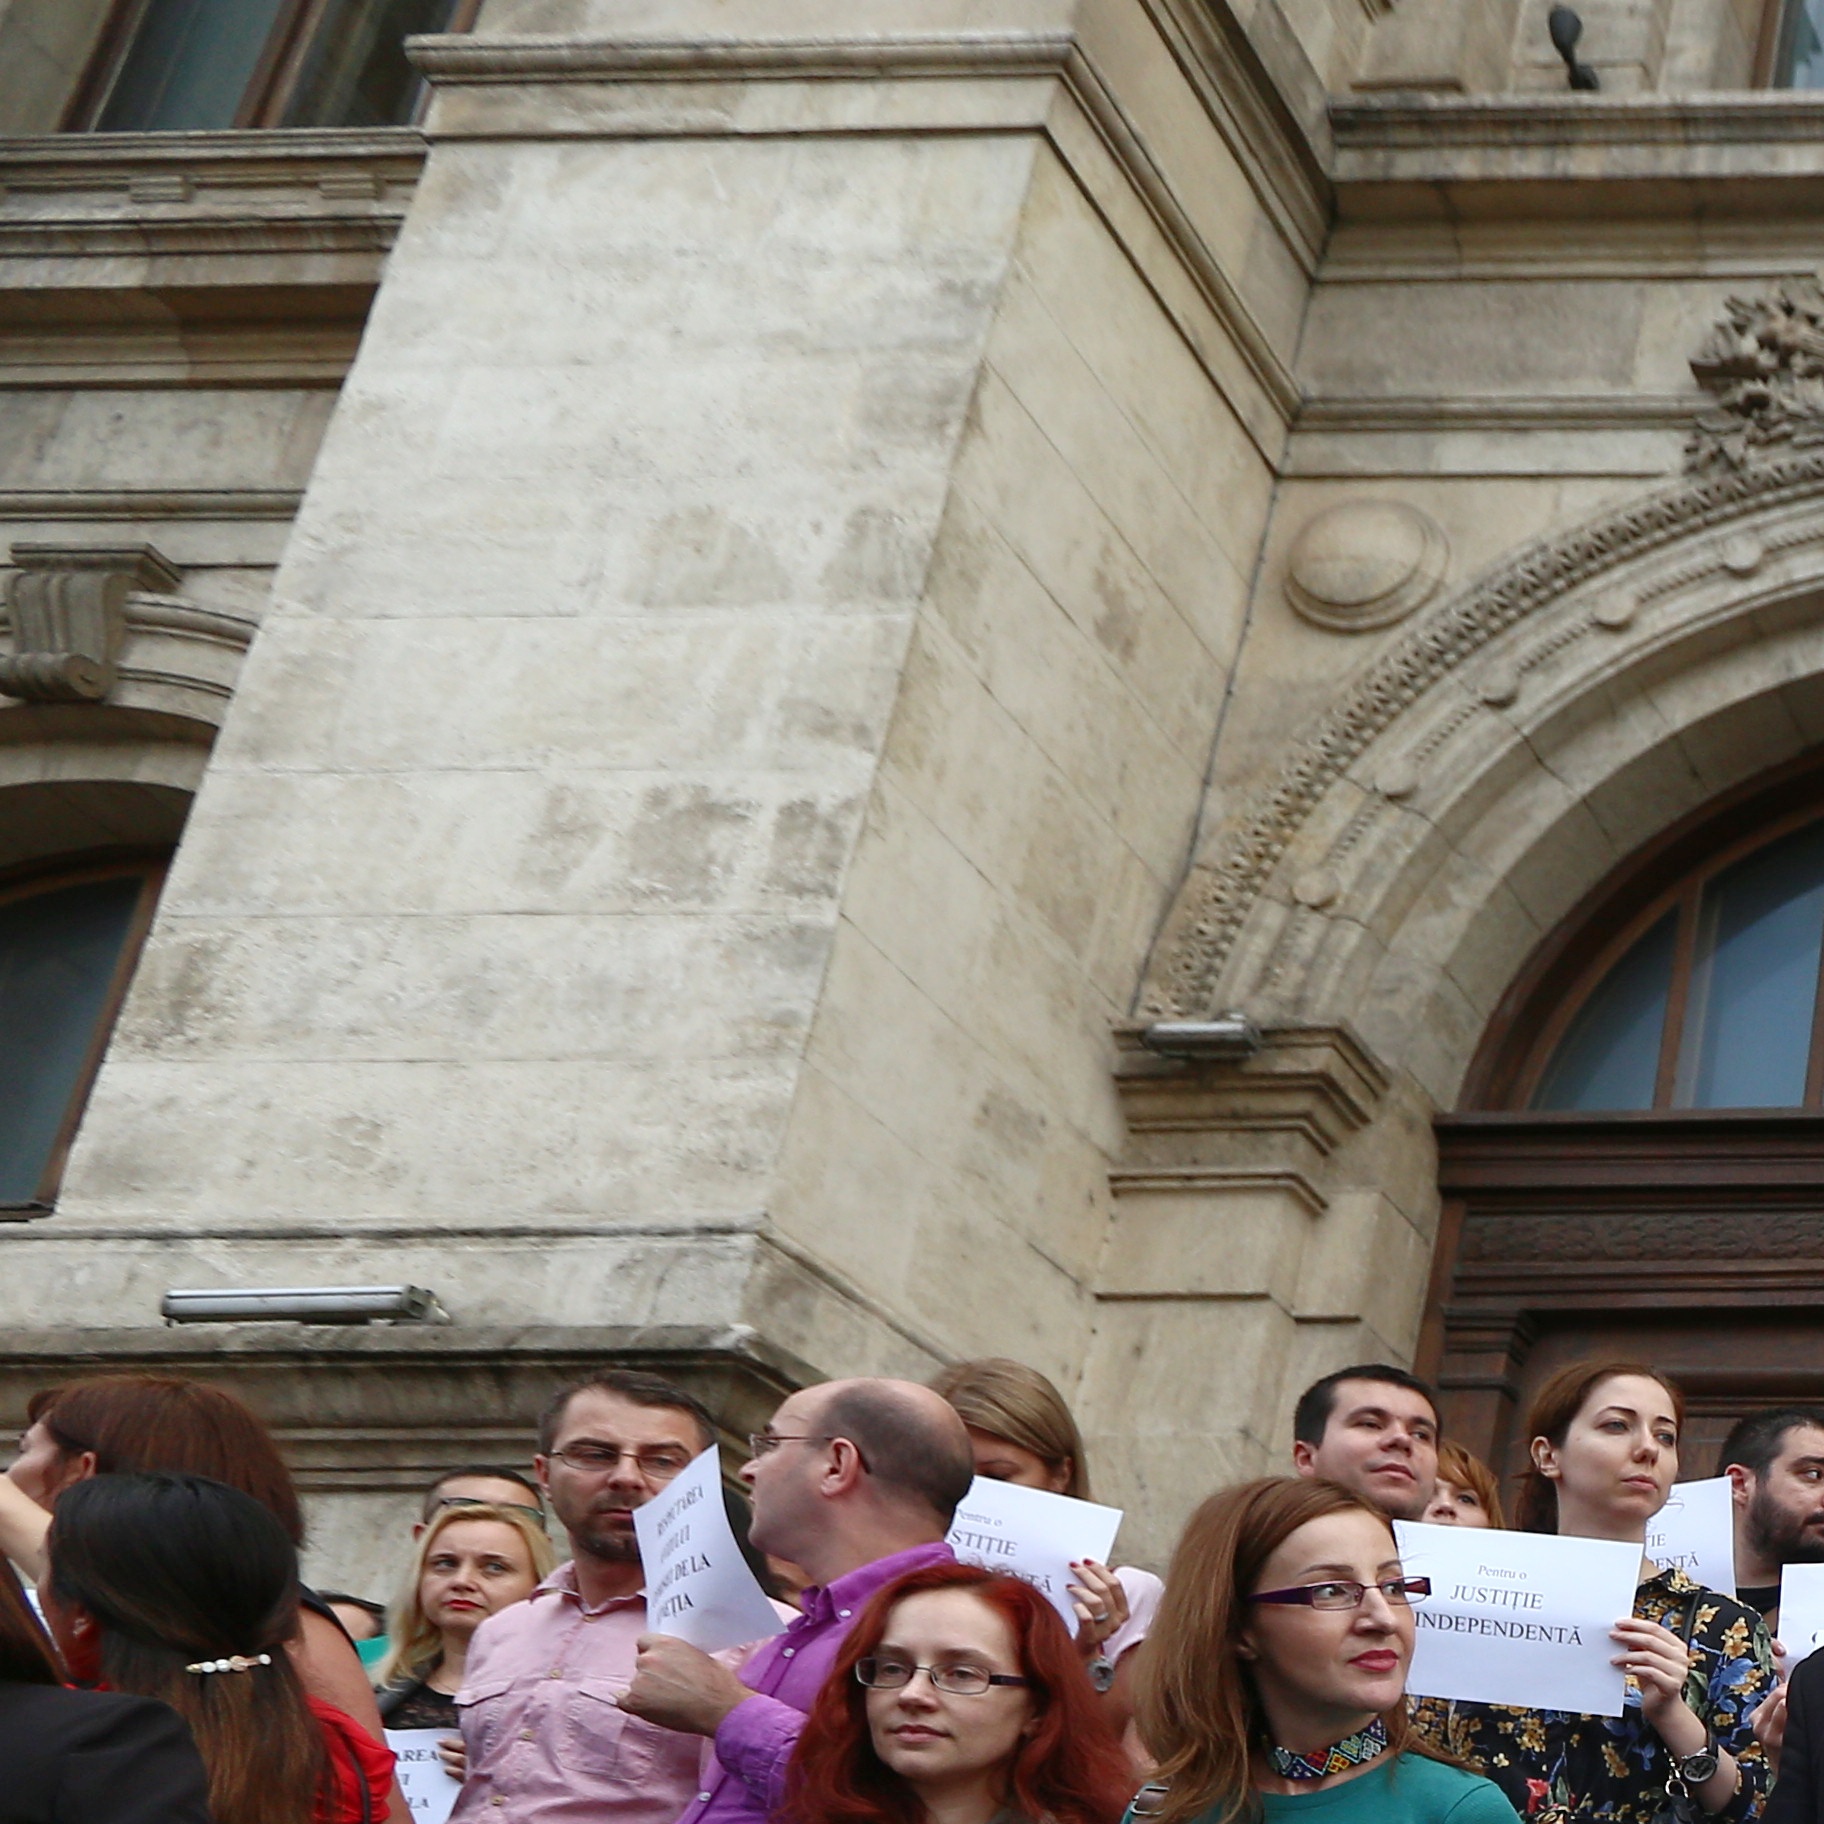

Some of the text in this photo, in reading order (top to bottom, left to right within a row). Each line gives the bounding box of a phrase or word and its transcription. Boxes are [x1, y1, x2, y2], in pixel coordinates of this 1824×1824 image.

[950, 1529, 1018, 1557] STIȚIE
[1477, 1565, 1527, 1580] Pentru o
[1450, 1584, 1544, 1610] JUSTIȚIE
[1415, 1611, 1583, 1646] INDEPENDENTĂ
